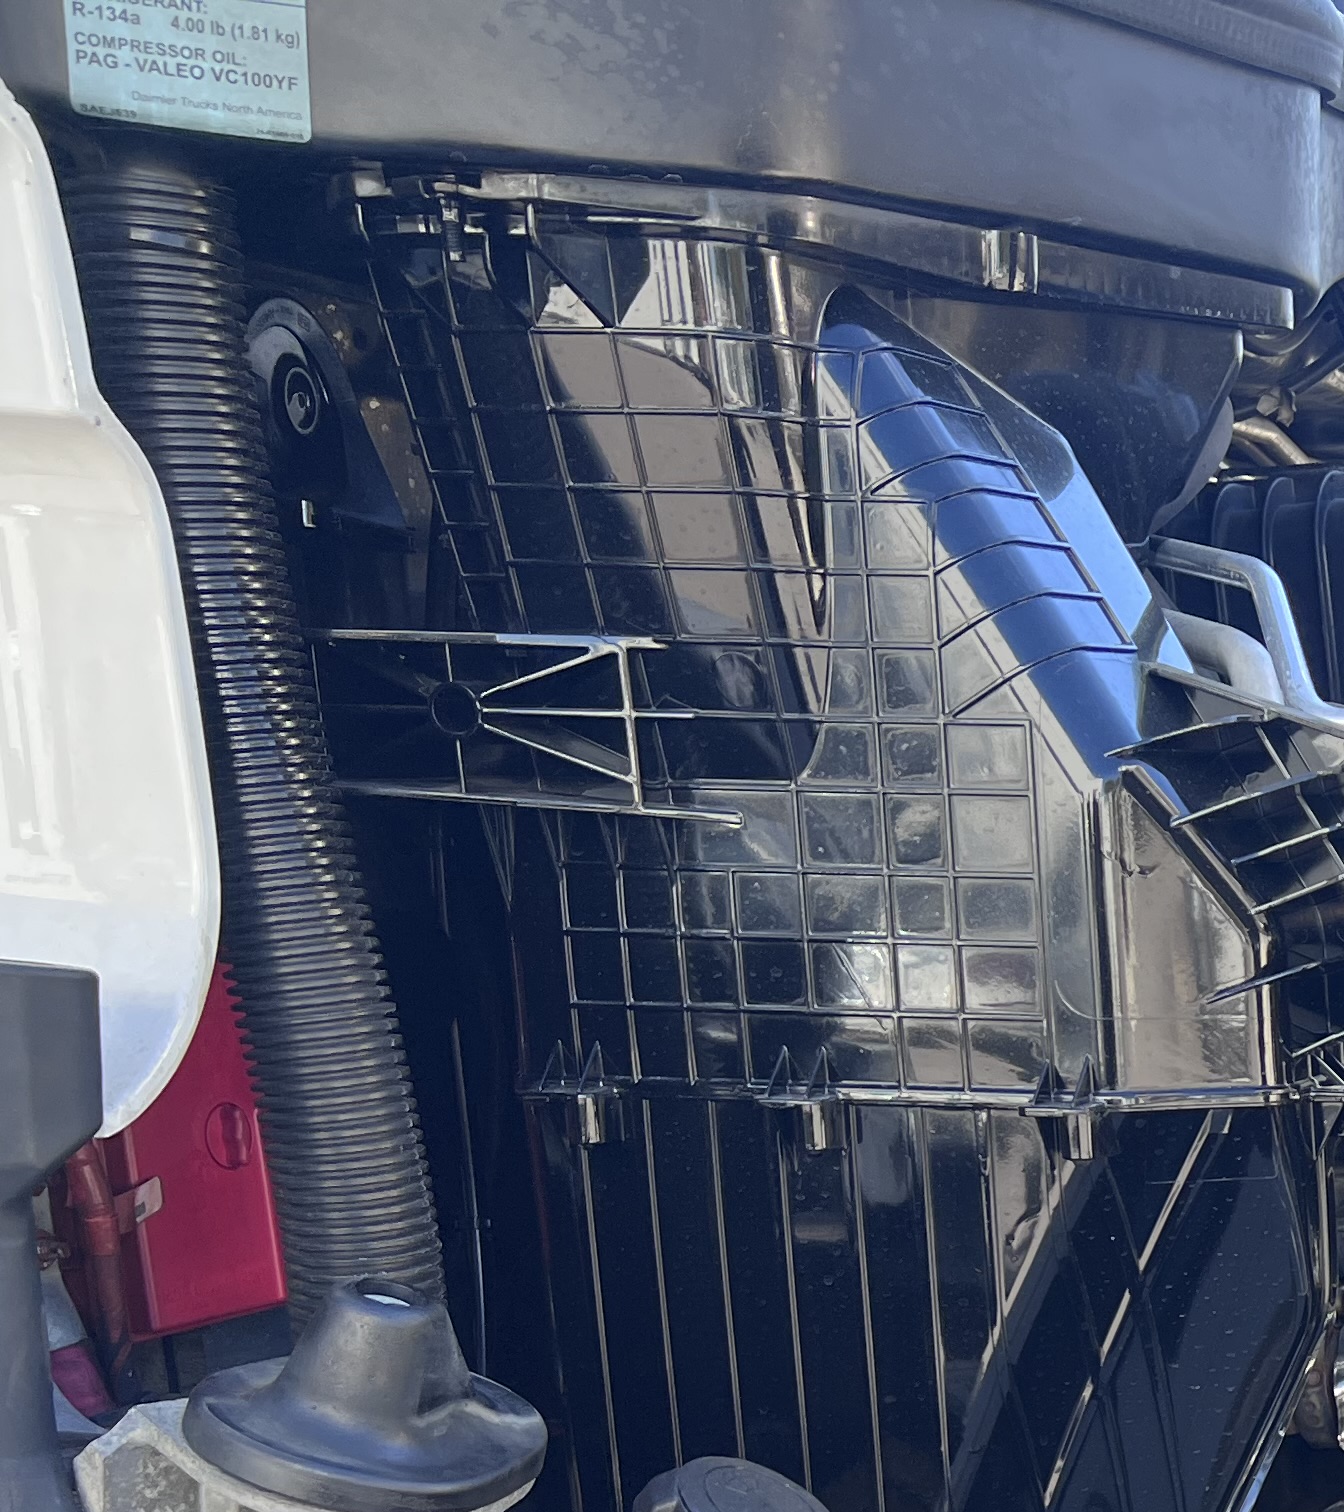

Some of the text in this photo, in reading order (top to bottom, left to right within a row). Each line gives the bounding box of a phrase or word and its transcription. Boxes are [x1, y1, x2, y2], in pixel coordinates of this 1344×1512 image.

[71, 1, 301, 49] R-134a 4.00 lb (1.81 kg)
[73, 31, 247, 67] COMPRESSOR OIL:
[75, 49, 119, 70] PAG
[135, 57, 205, 81] VALEO
[211, 67, 299, 92] VC100YF
[131, 91, 303, 121] Daimler Trucks North America
